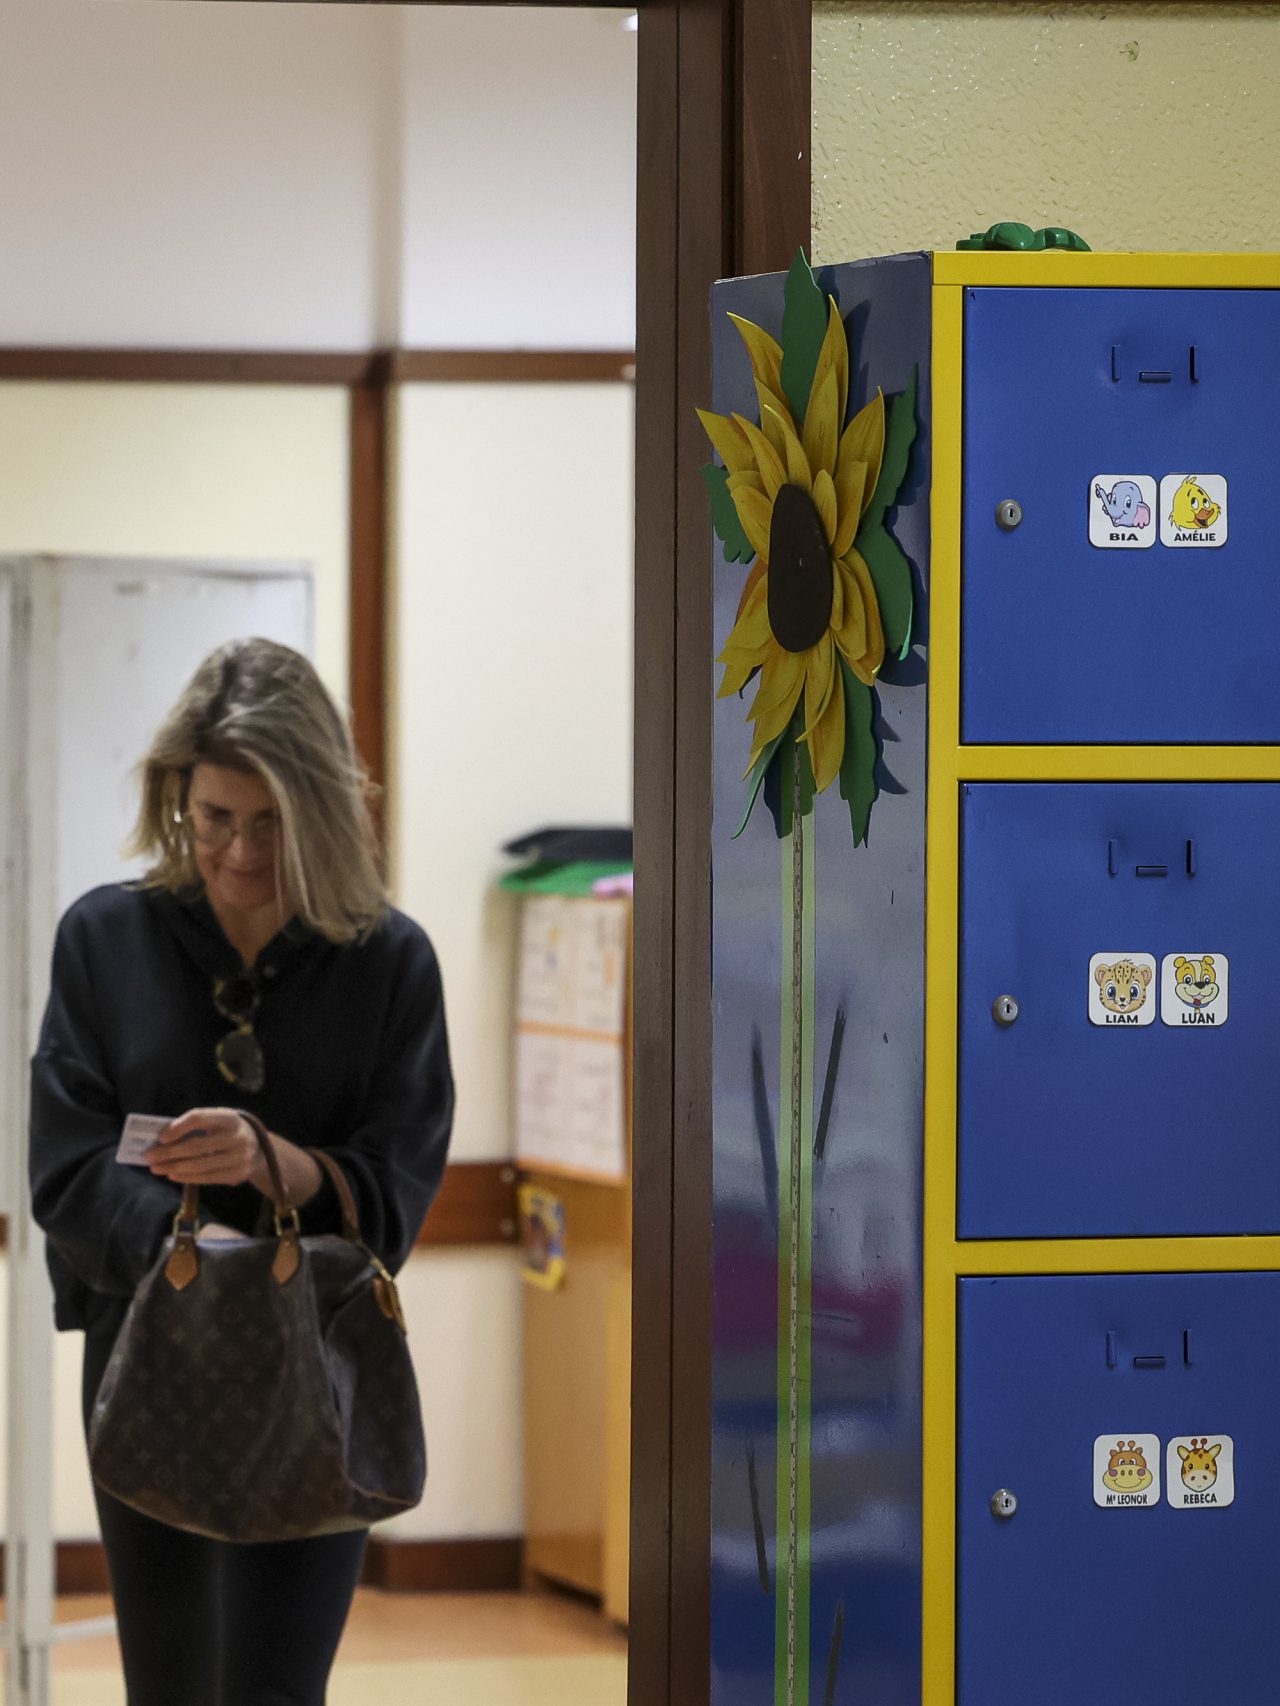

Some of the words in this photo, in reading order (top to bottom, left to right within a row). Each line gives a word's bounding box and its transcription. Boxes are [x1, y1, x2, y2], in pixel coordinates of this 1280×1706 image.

[1109, 533, 1139, 542] BIA
[1174, 530, 1216, 542] AMÉLIE
[1105, 1014, 1139, 1024] LIAM
[1181, 1012, 1215, 1024] LUAN
[1117, 1493, 1148, 1505] LEONOR
[1183, 1493, 1218, 1505] REBECA
